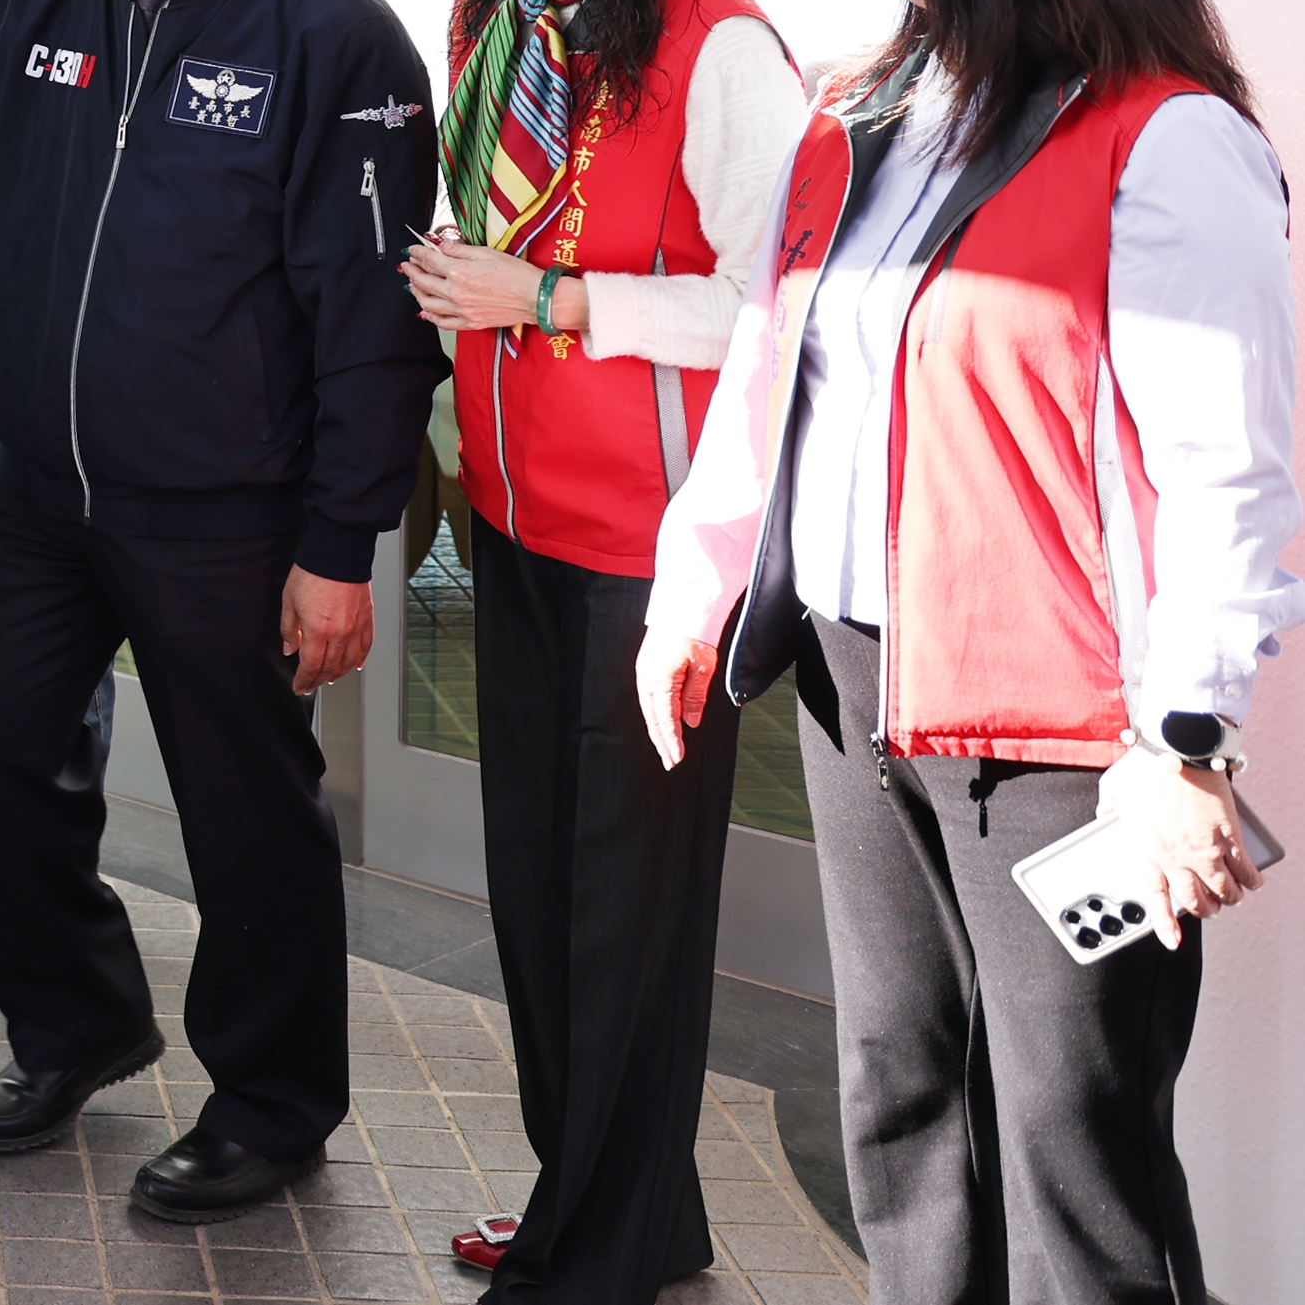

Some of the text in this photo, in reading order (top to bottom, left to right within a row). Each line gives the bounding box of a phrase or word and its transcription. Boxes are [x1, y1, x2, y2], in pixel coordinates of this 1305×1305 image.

[25, 43, 97, 89] C-130H
[188, 96, 251, 119] 臺南市長
[196, 109, 239, 128] 黃偉哲
